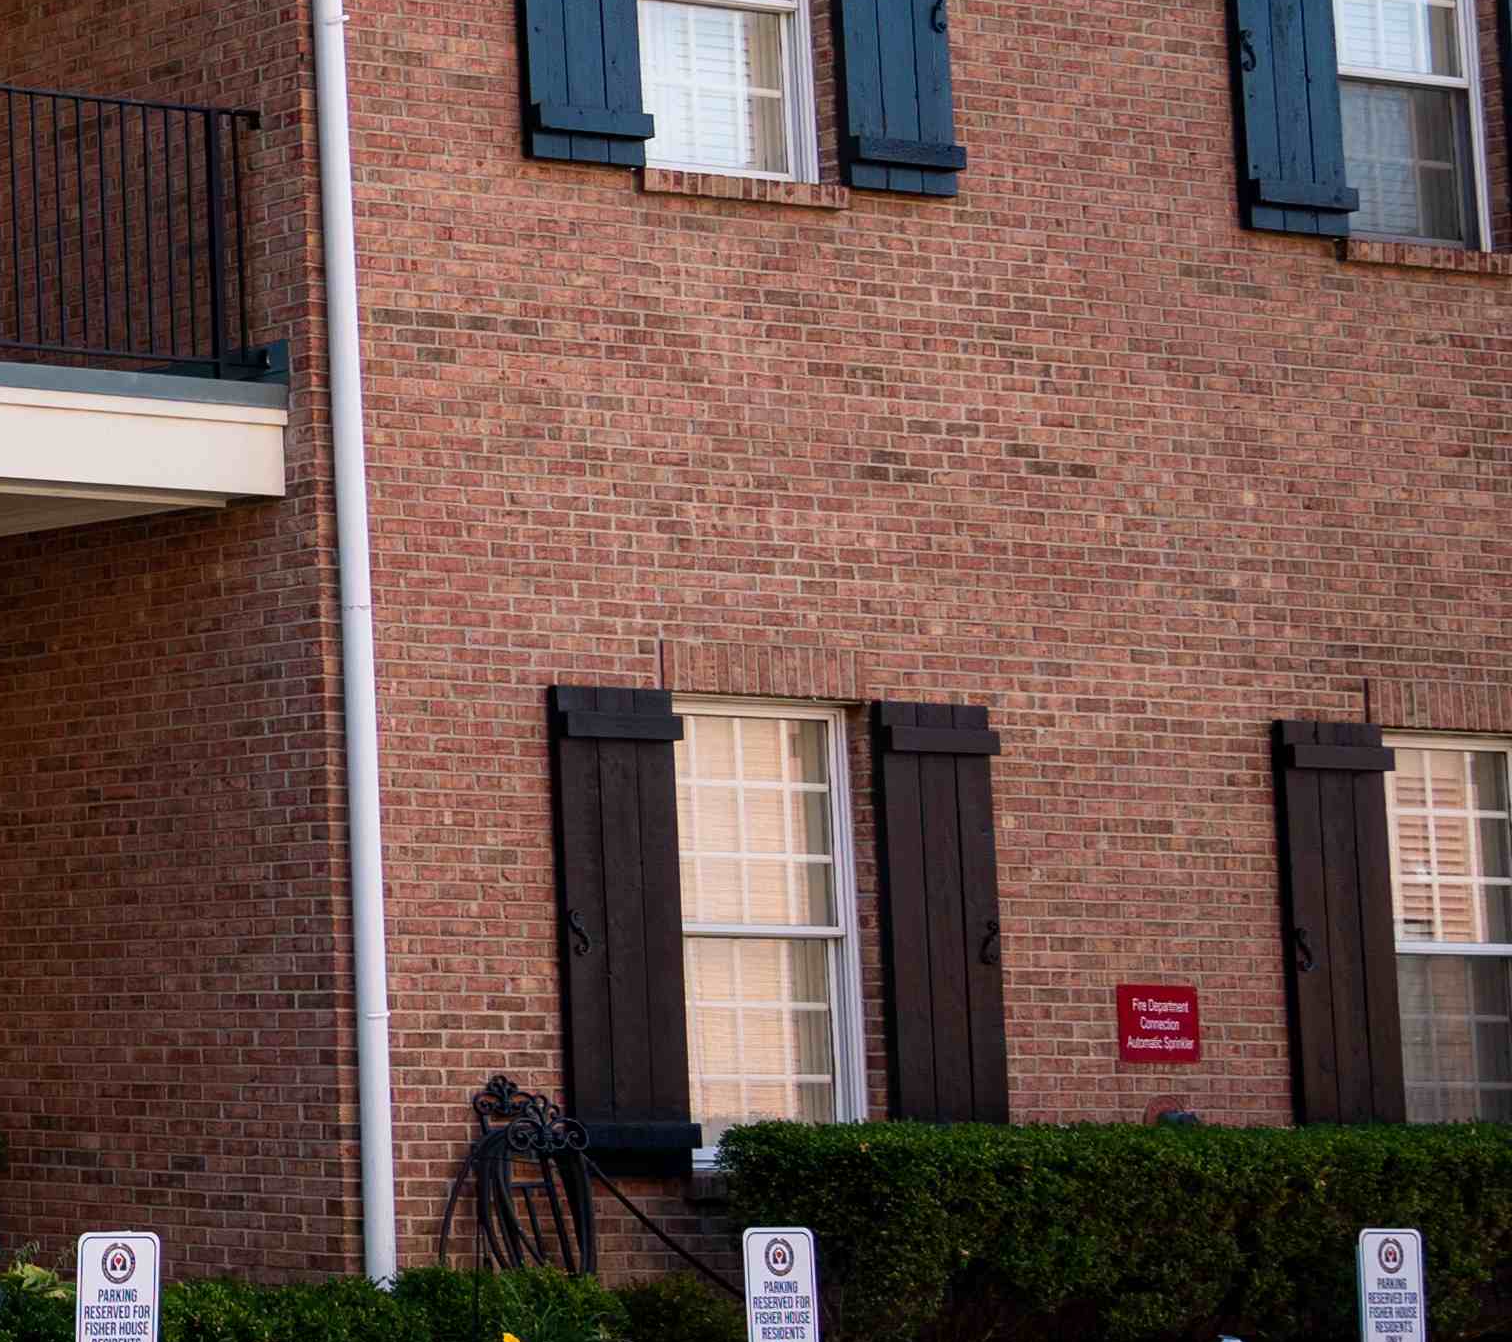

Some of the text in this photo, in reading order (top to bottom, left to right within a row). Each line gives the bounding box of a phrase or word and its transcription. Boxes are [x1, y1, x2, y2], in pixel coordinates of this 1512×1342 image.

[1132, 998, 1189, 1014] Fire Department
[1140, 1016, 1180, 1030] Connection
[1126, 1035, 1162, 1049] Automatic
[764, 1280, 798, 1293] PARKING
[98, 1288, 138, 1303] PARKING
[753, 1295, 810, 1309] RESERVED FOR
[84, 1305, 150, 1320] RESERVED FOR
[755, 1311, 810, 1324] FISHER HOUSE
[84, 1321, 149, 1336] FISHER HOUSE
[761, 1327, 805, 1340] RESIDENTS
